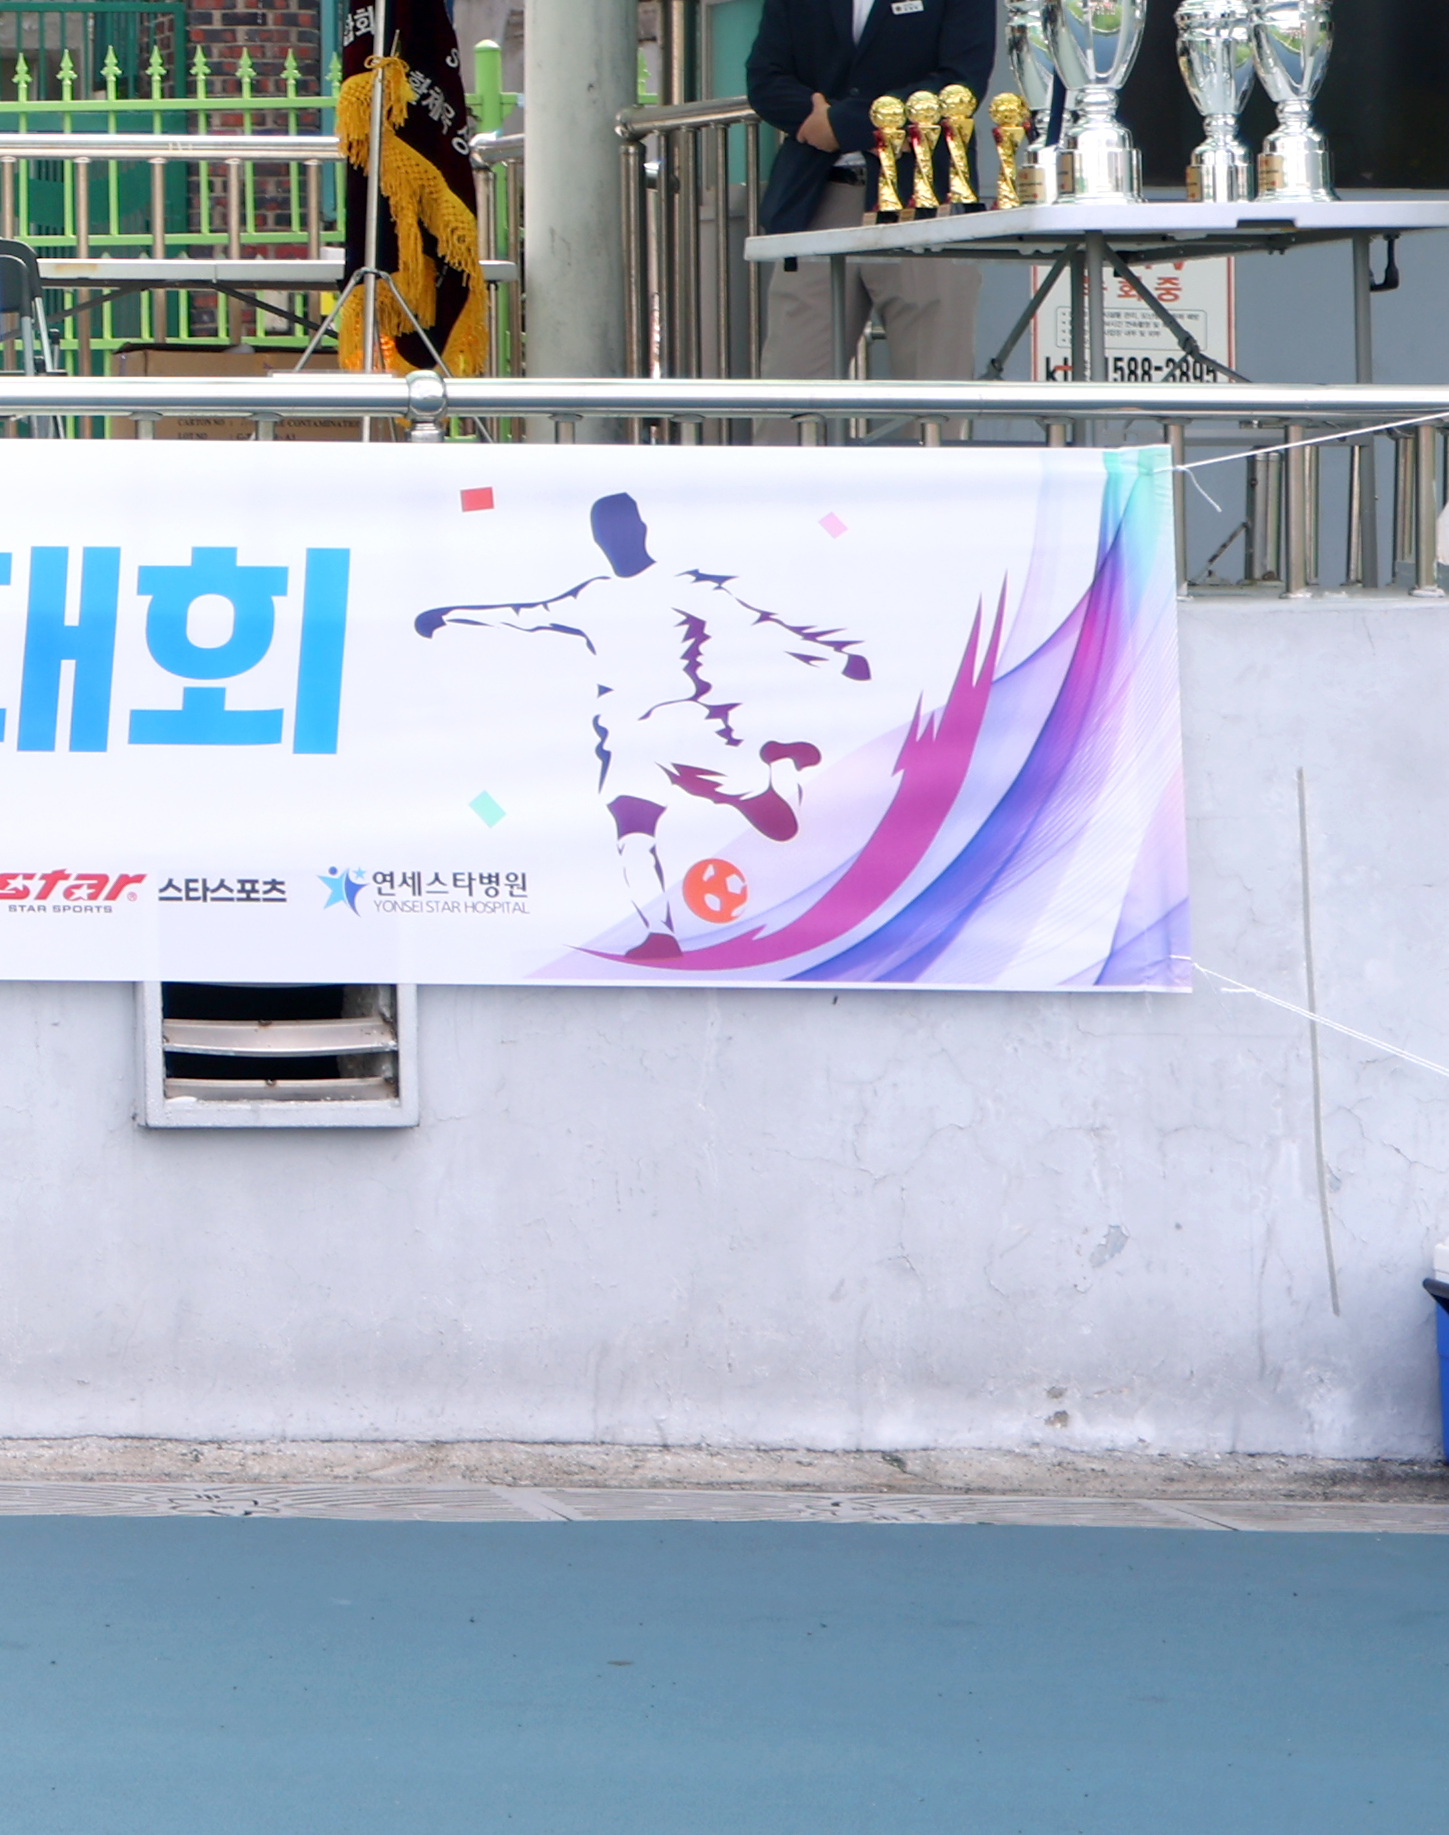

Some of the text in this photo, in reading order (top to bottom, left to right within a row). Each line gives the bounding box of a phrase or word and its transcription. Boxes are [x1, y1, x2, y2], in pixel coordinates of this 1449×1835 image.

[159, 878, 287, 902] 스타스포츠
[373, 871, 527, 898] 연세스타병원
[53, 905, 112, 913] SPORTS
[374, 900, 529, 914] YONSEI STAR HOSPITAL
